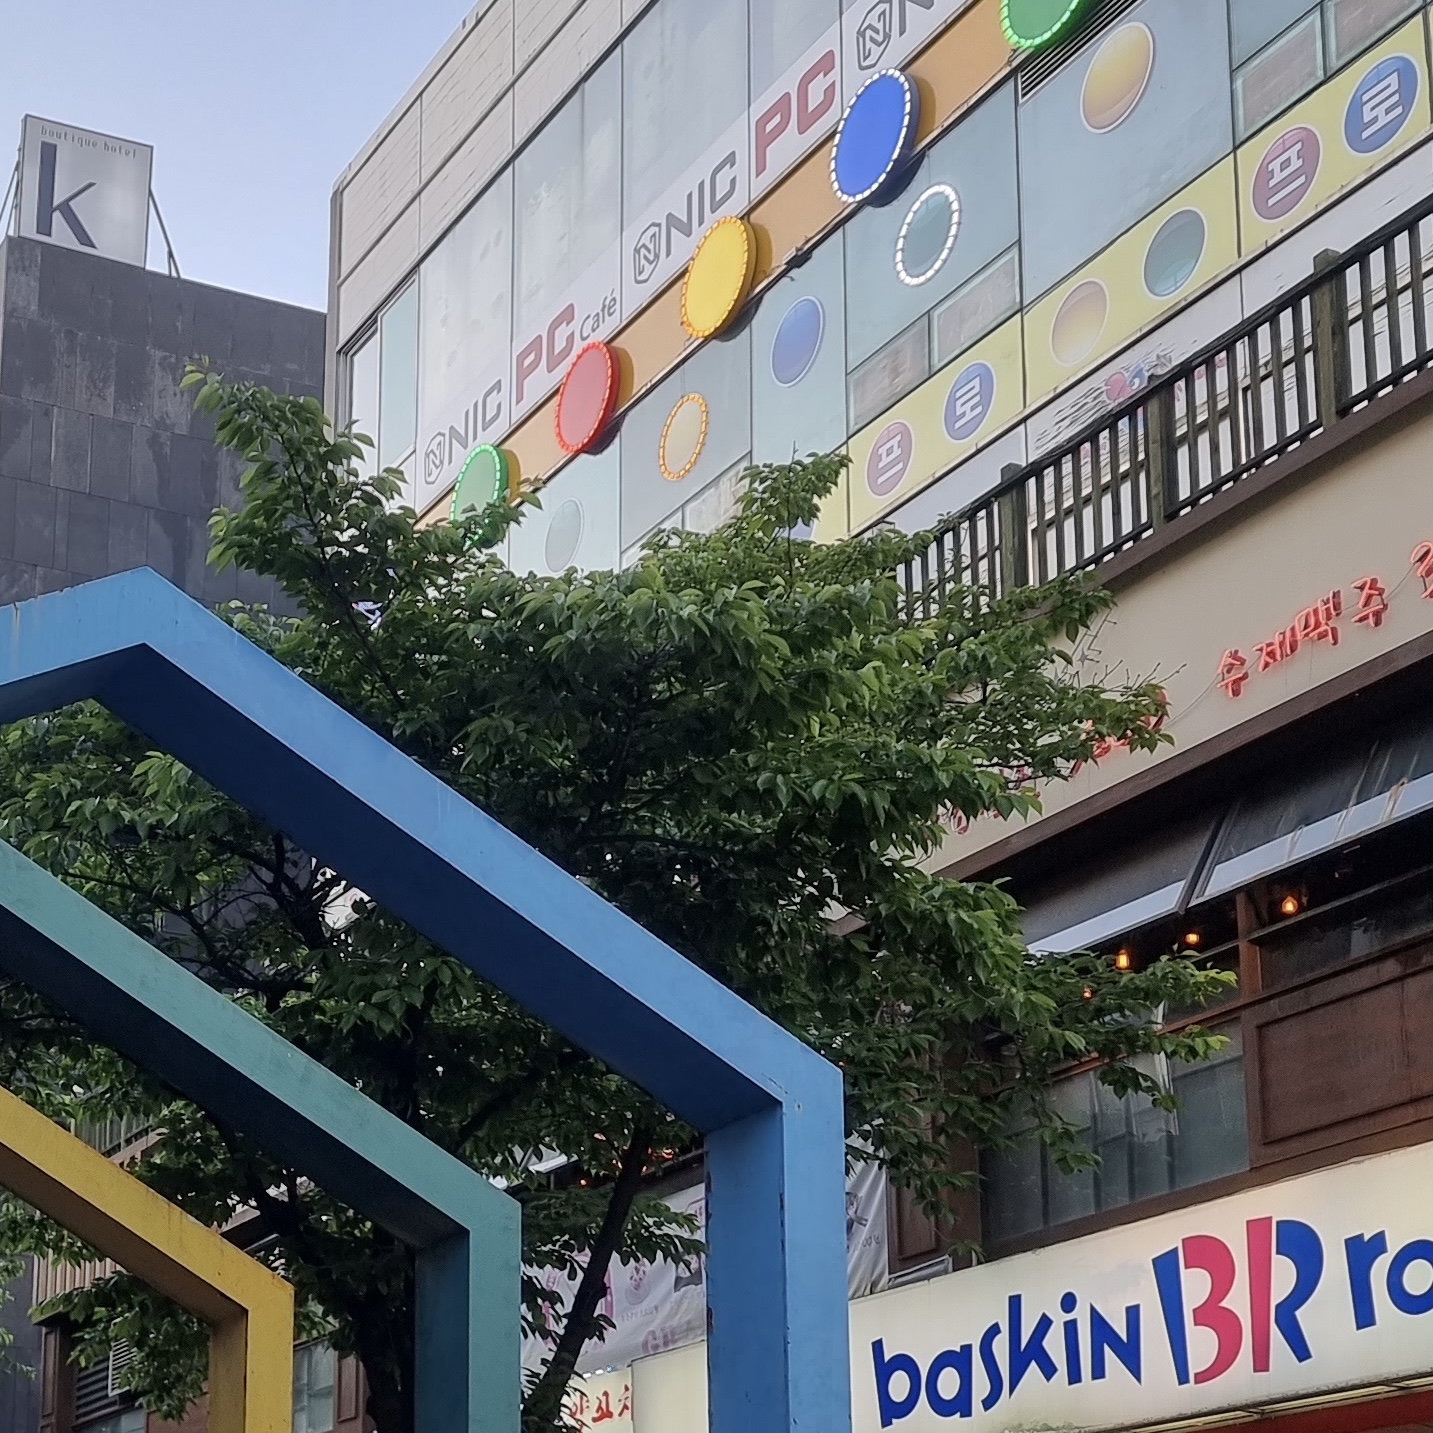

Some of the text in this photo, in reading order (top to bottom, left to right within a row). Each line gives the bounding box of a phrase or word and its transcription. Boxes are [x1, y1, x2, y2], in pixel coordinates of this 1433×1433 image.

[41, 125, 136, 159] boutique hotel
[755, 49, 835, 179] PC
[516, 303, 575, 407] PC
[580, 288, 618, 342] Café
[1151, 1216, 1325, 1386] BR
